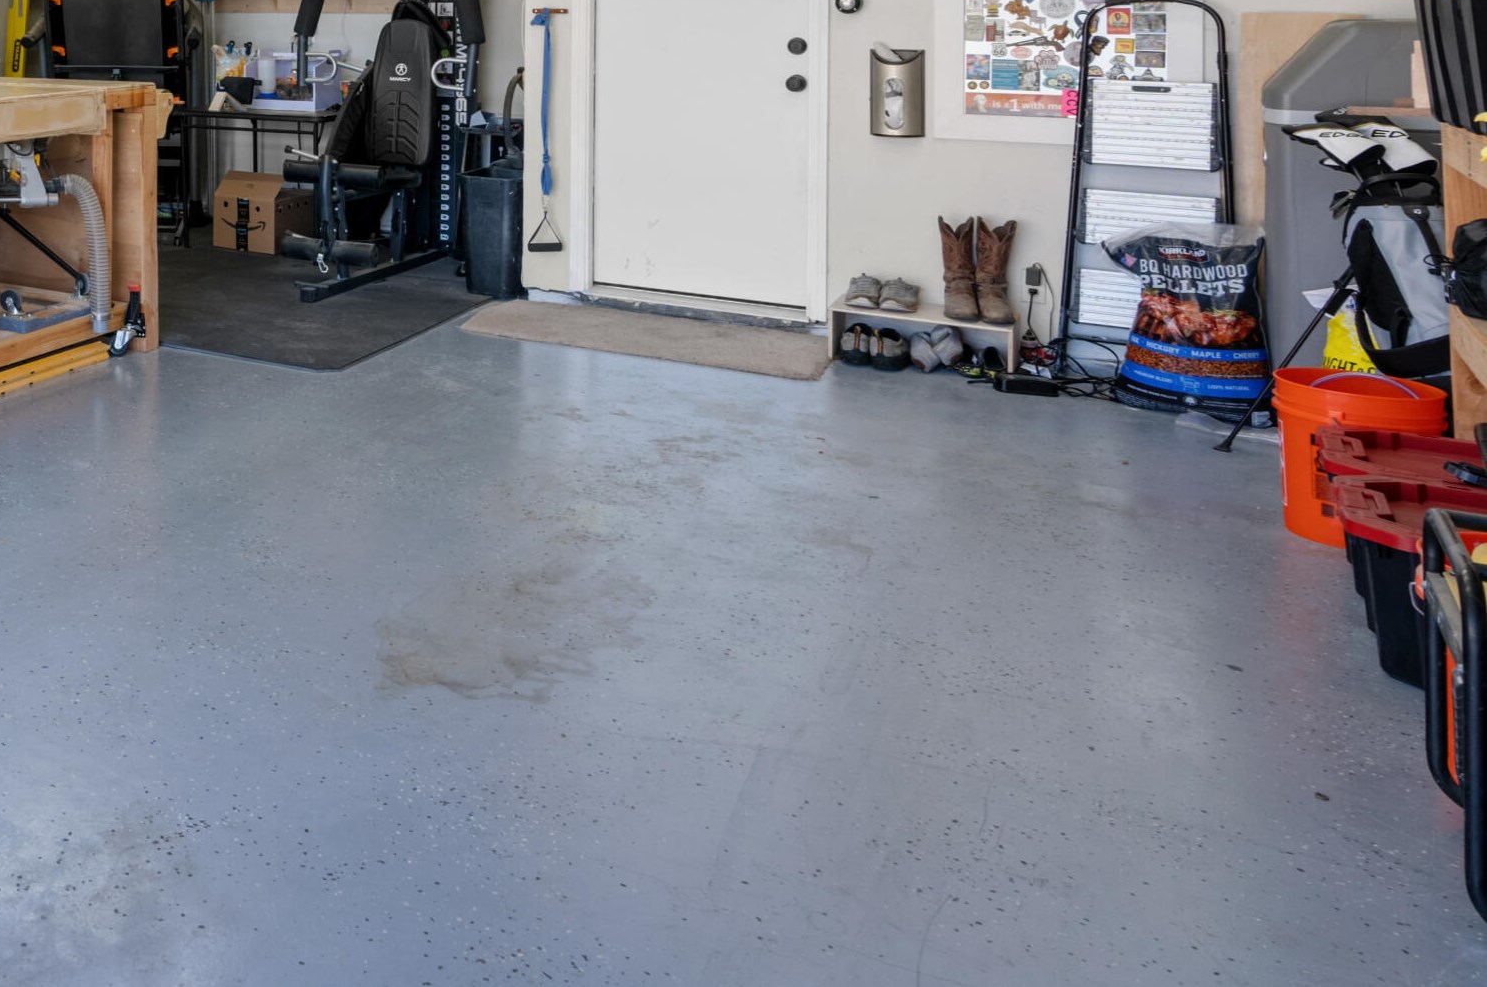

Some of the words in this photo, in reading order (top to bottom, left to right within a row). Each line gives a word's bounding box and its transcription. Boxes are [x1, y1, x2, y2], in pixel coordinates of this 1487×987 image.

[1162, 262, 1249, 281] HARDWOOD
[1140, 273, 1246, 297] PELLETS
[1146, 340, 1181, 355] HICKORY
[1191, 349, 1222, 359] MAPLE
[1232, 351, 1261, 359] CHERRY
